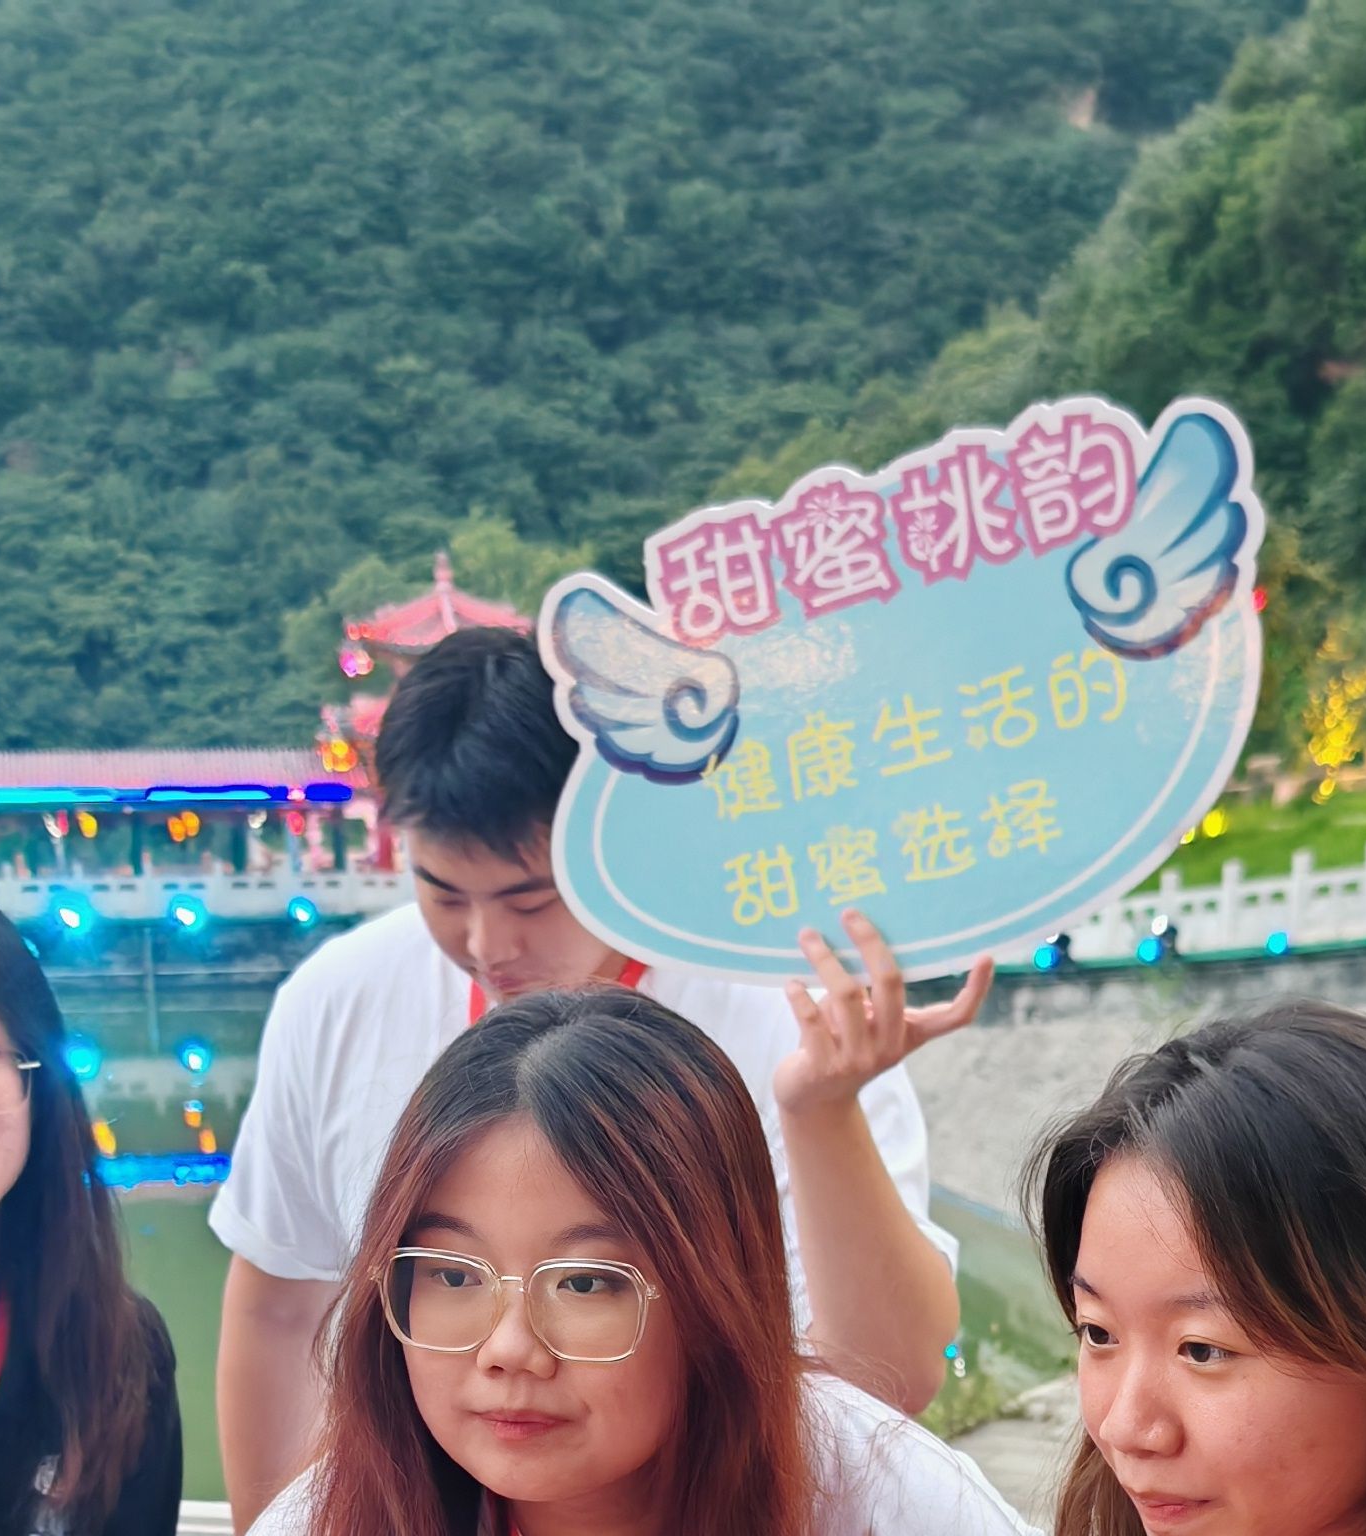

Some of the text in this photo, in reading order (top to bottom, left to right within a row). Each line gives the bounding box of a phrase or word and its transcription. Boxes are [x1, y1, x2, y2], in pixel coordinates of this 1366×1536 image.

[701, 648, 1128, 820] 健康生活的
[723, 779, 1064, 926] 甜蜜选择
